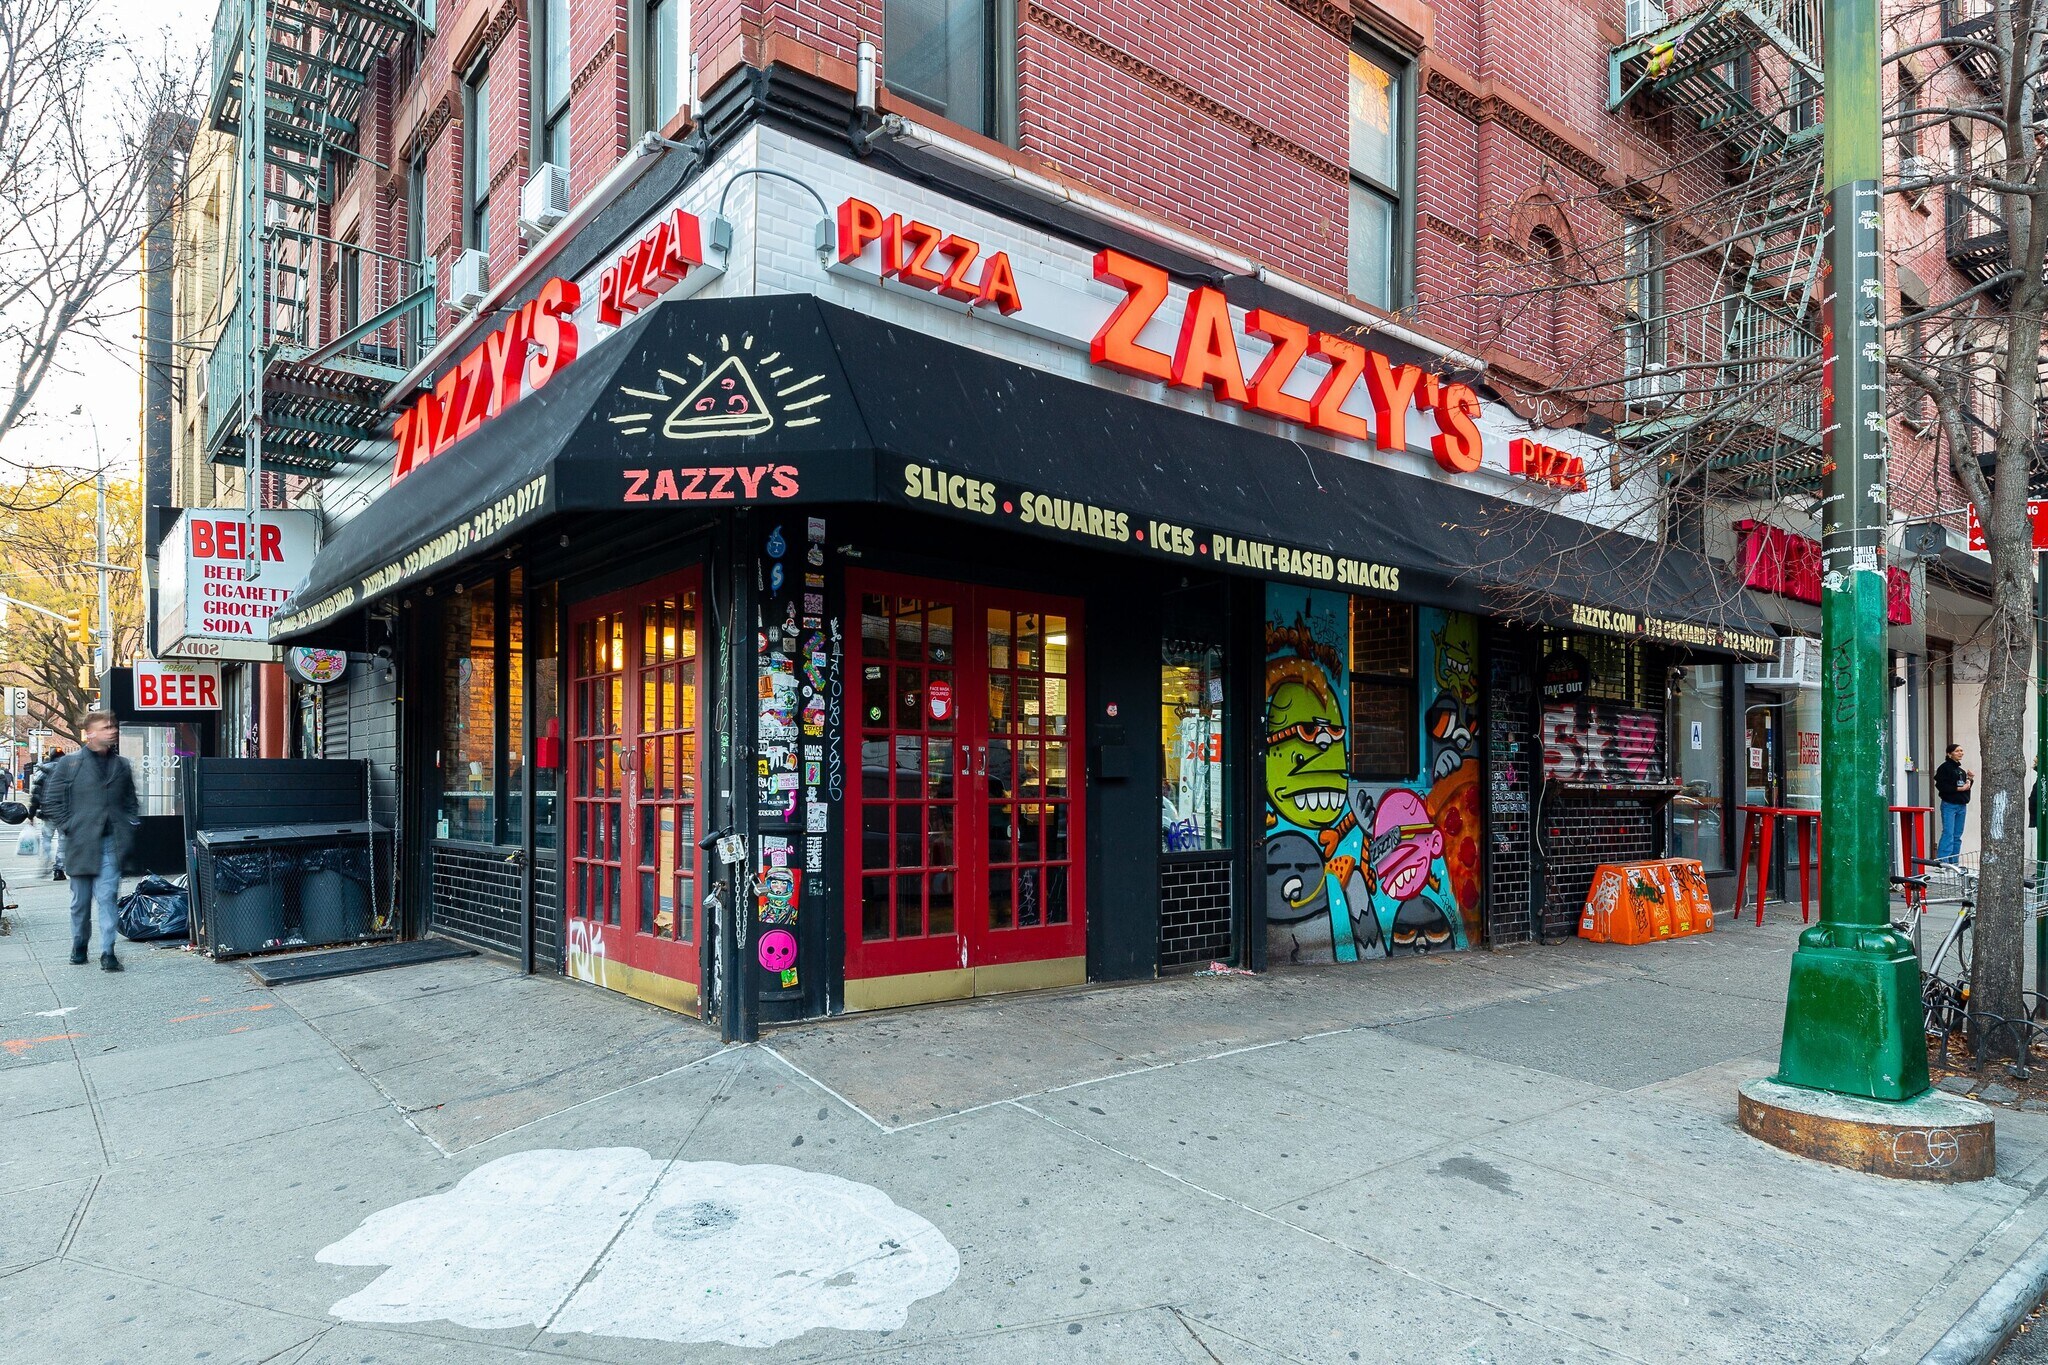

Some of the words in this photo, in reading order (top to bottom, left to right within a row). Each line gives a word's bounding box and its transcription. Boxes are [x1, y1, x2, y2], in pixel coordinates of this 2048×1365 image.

[597, 208, 703, 327] PIZZA
[837, 196, 1023, 316] PIZZA
[390, 277, 581, 488] ZAZZY'S
[1090, 248, 1484, 474] ZAZZY'S
[623, 463, 799, 501] ZAZZY'S
[1509, 438, 1588, 493] PIZZA
[419, 529, 458, 571] ORCHARD
[458, 522, 470, 551] ST
[474, 508, 494, 543] 212
[494, 494, 516, 530] 542
[517, 474, 547, 517] 0177
[904, 463, 997, 515] SLICES
[1019, 491, 1129, 543] SQUARES
[1150, 520, 1195, 557] ICES
[1213, 533, 1334, 581] PLANT-BASED
[1337, 557, 1400, 592] SNACKS
[203, 583, 293, 602] CIGARETT
[202, 619, 252, 635] SODA
[1572, 603, 1636, 634] ZAZZYS.COM
[1644, 617, 1662, 638] 173
[1663, 620, 1706, 645] ORCHARD
[1707, 628, 1717, 646] ST
[1723, 630, 1739, 650] 212
[1740, 634, 1755, 653] 542
[1755, 636, 1774, 655] 0177
[140, 674, 217, 706] BEER
[162, 664, 194, 672] SPECIAL
[1543, 683, 1565, 696] TAKE
[1565, 681, 1583, 694] OUT
[1803, 749, 1820, 765] BURGER
[1805, 732, 1819, 748] STREET
